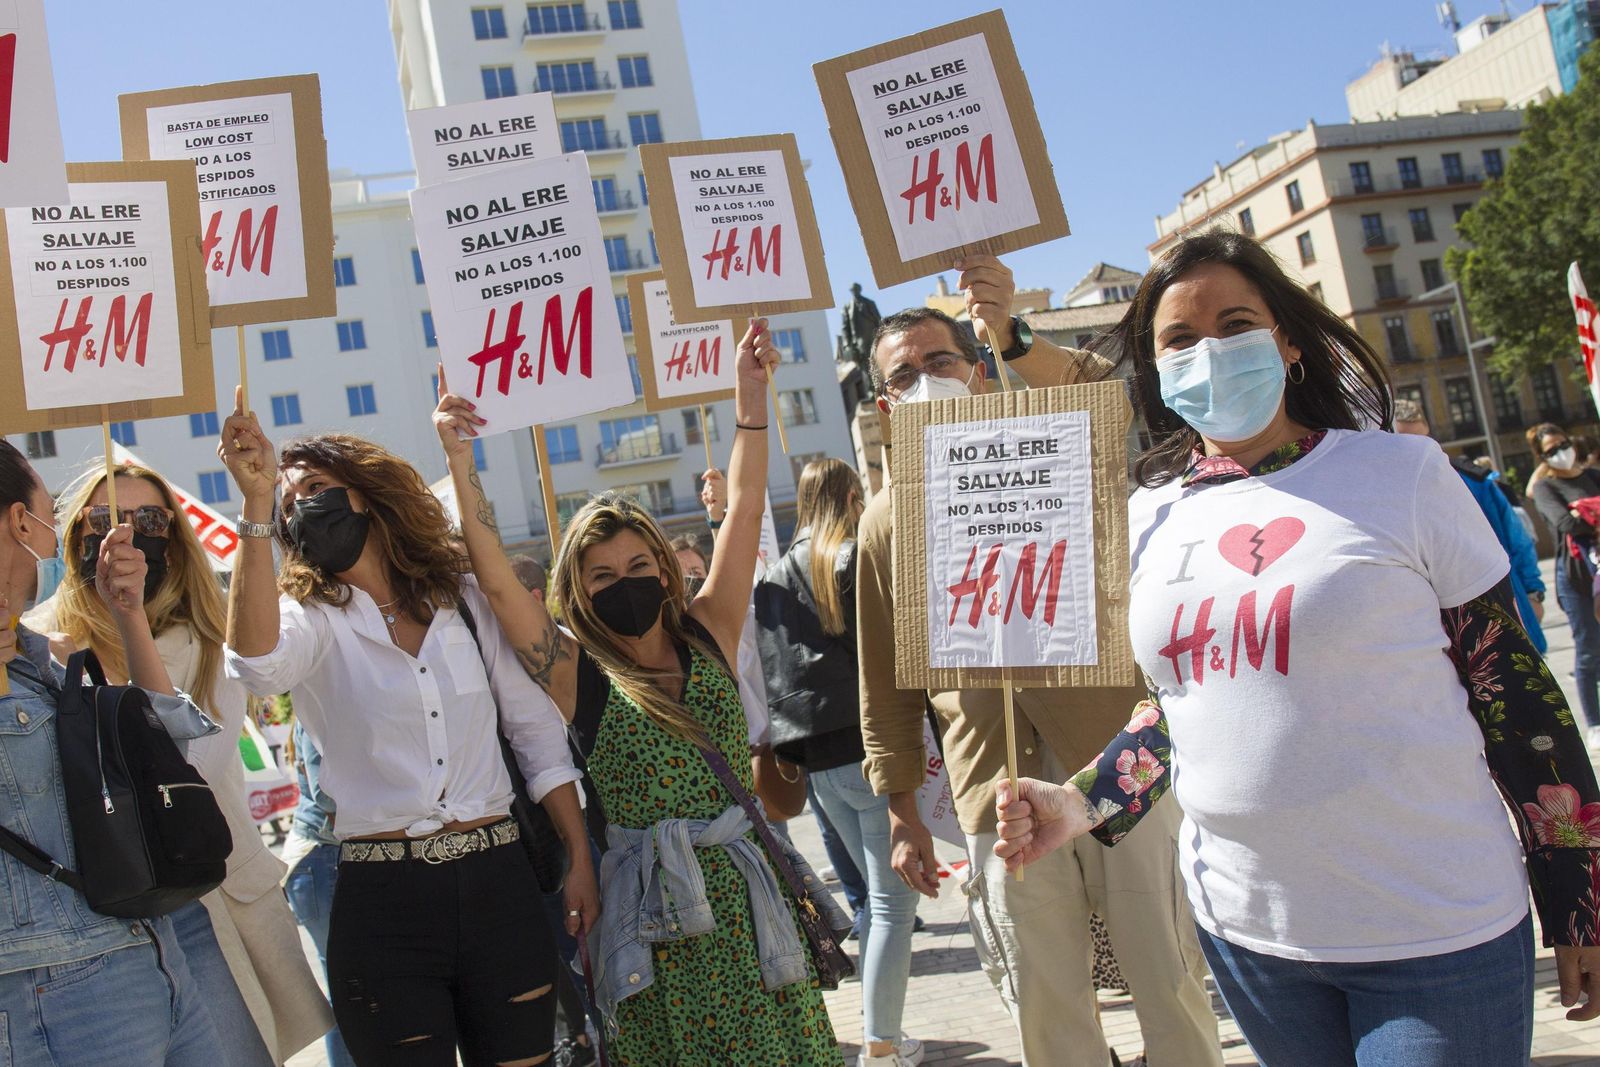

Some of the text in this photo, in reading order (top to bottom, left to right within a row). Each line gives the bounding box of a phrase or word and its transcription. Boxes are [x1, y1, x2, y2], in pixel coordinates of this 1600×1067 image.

[872, 59, 967, 97] NO AL ERE
[886, 83, 967, 116] SALVAJE
[167, 113, 269, 133] BASTA DE EMPLEO
[434, 115, 537, 144] NO AL ERE
[884, 103, 981, 138] NO A LOS 1.100
[185, 132, 253, 149] LOW COST
[906, 124, 970, 150] DESPIDOS
[213, 154, 222, 165] A
[226, 151, 252, 163] LOS
[447, 142, 534, 168] SALVAJE
[198, 168, 255, 183] ESPIDOS
[690, 164, 766, 180] NO AL ERE
[900, 133, 998, 225] H&M
[699, 182, 764, 197] SALVAJE
[32, 204, 141, 221] NO AL ERE
[446, 184, 568, 226] NO AL ERE
[694, 199, 775, 213] NO A LOS 1.100
[711, 213, 764, 224] DESPIDOS
[43, 231, 135, 247] SALVAJE
[461, 216, 565, 254] SALVAJE
[35, 256, 148, 272] NO A LOS 1.100
[455, 244, 582, 283] NO A LOS 1.100
[702, 223, 781, 281] H&M
[57, 276, 130, 290] DESPIDOS
[481, 272, 564, 300] DESPIDOS
[39, 292, 153, 373] H&M
[467, 286, 593, 398] H&M
[660, 324, 720, 337] INJUSTIFICADOS
[664, 335, 721, 382] H&M
[949, 439, 1059, 462] NO AL ERE
[957, 469, 1051, 490] SALVAJE
[948, 498, 1063, 516] NO A LOS 1.100
[967, 521, 1043, 537] DESPIDOS
[1166, 539, 1205, 585] I
[946, 539, 1068, 629] H&M
[1158, 583, 1295, 686] H&M
